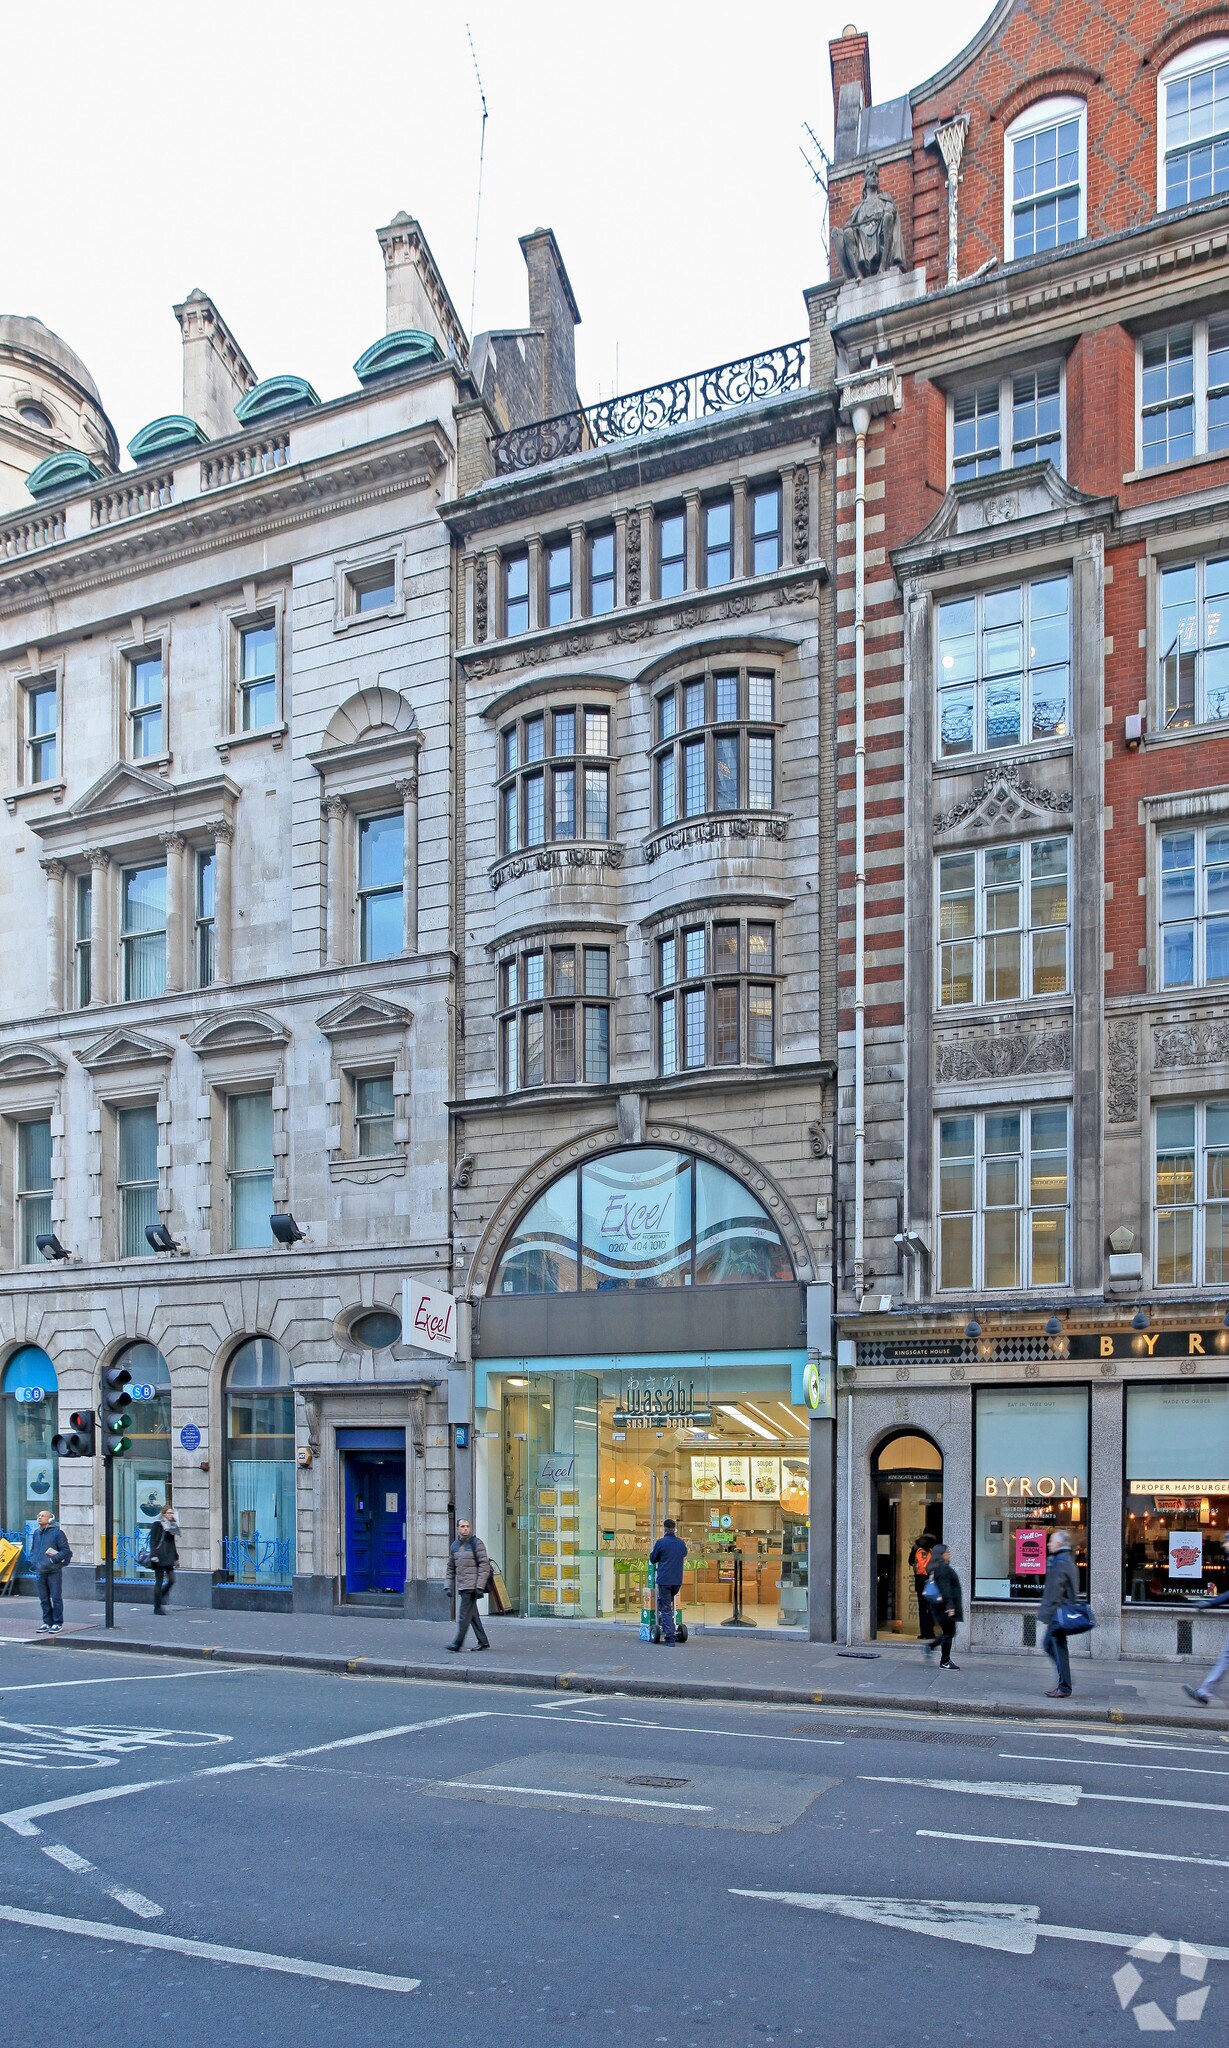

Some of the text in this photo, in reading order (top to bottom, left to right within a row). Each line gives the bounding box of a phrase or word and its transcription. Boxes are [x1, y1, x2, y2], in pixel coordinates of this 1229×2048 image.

[601, 1193, 672, 1241] Excel
[608, 1240, 667, 1253] 0207 404 1010
[415, 1297, 452, 1341] Excel
[1100, 1333, 1206, 1357] BYR
[627, 1374, 676, 1390] わさび
[627, 1380, 694, 1414] wasabi
[626, 1417, 653, 1429] sushi
[666, 1416, 694, 1428] bento
[542, 1458, 574, 1482] Excel
[728, 1459, 742, 1467] sushi
[985, 1477, 1078, 1497] BYRON
